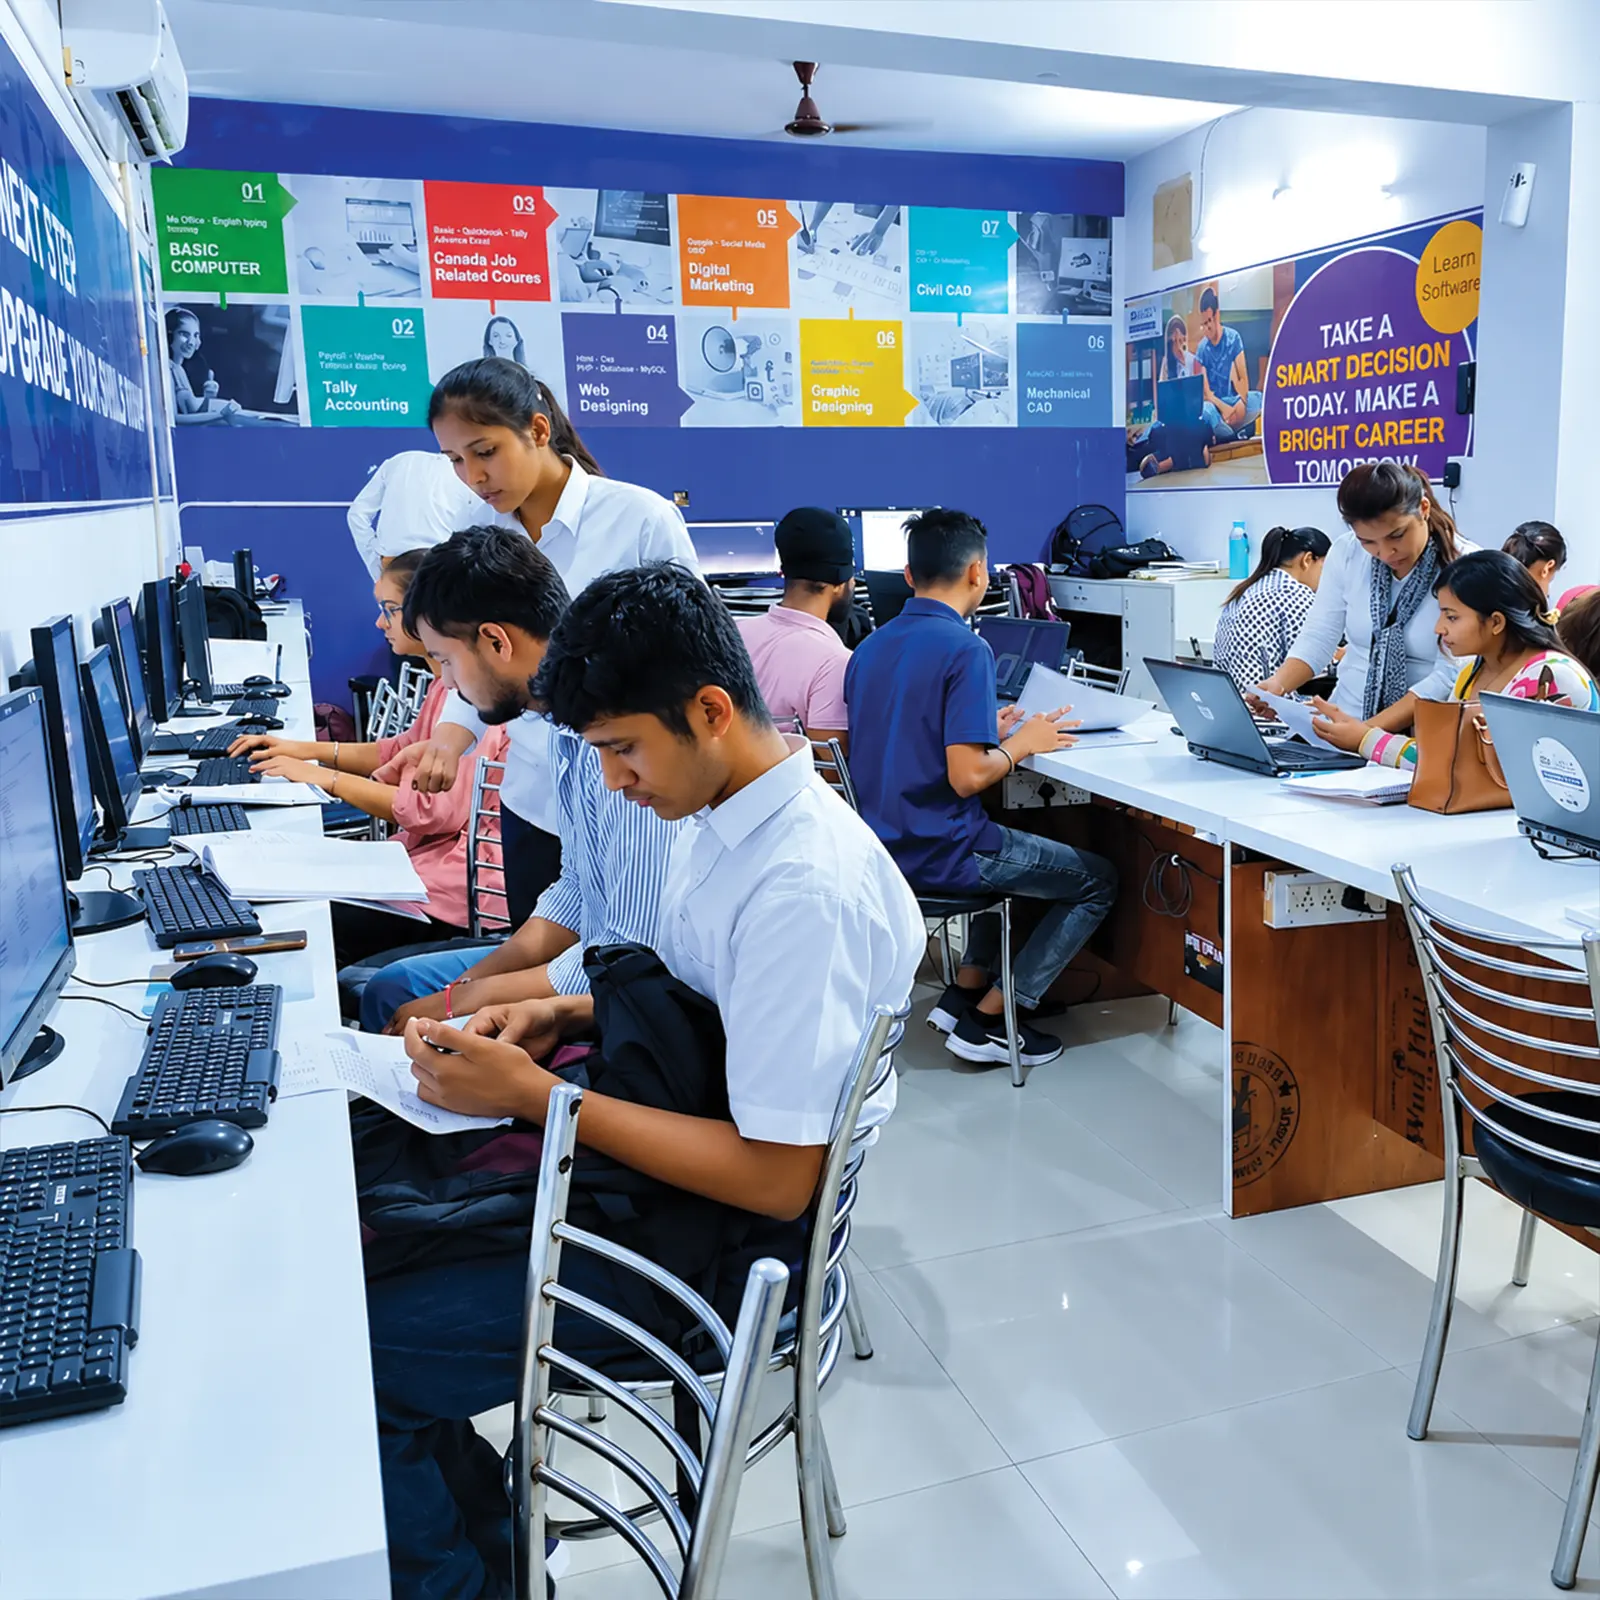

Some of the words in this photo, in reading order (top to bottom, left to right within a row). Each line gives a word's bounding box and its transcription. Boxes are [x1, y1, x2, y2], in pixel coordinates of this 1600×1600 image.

[241, 182, 263, 200] 01
[513, 195, 535, 212] 03
[757, 209, 777, 225] 05
[0, 156, 44, 270] NEXT
[43, 203, 77, 298] STEP
[981, 220, 1000, 235] 07
[169, 242, 219, 257] BASIC
[433, 251, 488, 267] Canada
[491, 253, 517, 267] Job
[1433, 251, 1476, 274] Learn
[171, 260, 261, 276] COMPUTER
[688, 262, 730, 278] Digital
[435, 268, 489, 283] Related
[491, 269, 542, 285] Coures
[690, 278, 754, 295] Marketing
[916, 283, 943, 297] Civil
[945, 284, 972, 297] CAD
[1422, 277, 1481, 302] Software
[392, 318, 415, 335] 02
[647, 325, 668, 340] 04
[1320, 316, 1374, 349] TAKE
[1377, 313, 1394, 340] A
[876, 330, 896, 346] 06
[1087, 335, 1105, 349] 06
[1276, 357, 1341, 389] SMART
[1346, 340, 1451, 380] DECISION
[322, 380, 358, 397] Tally
[578, 383, 610, 396] Web
[811, 384, 860, 398] Graphic
[1026, 387, 1091, 399] Mechanical
[324, 398, 409, 414] Accounting
[580, 399, 649, 416] Designing
[812, 400, 874, 416] Designing
[1026, 401, 1053, 413] CAD
[1282, 391, 1349, 420] TODAY.
[1354, 382, 1418, 413] MAKE
[1421, 380, 1440, 407] A
[1279, 425, 1350, 452] BRIGHT
[1354, 417, 1445, 448] CAREER
[1295, 454, 1418, 484] TOMOW
